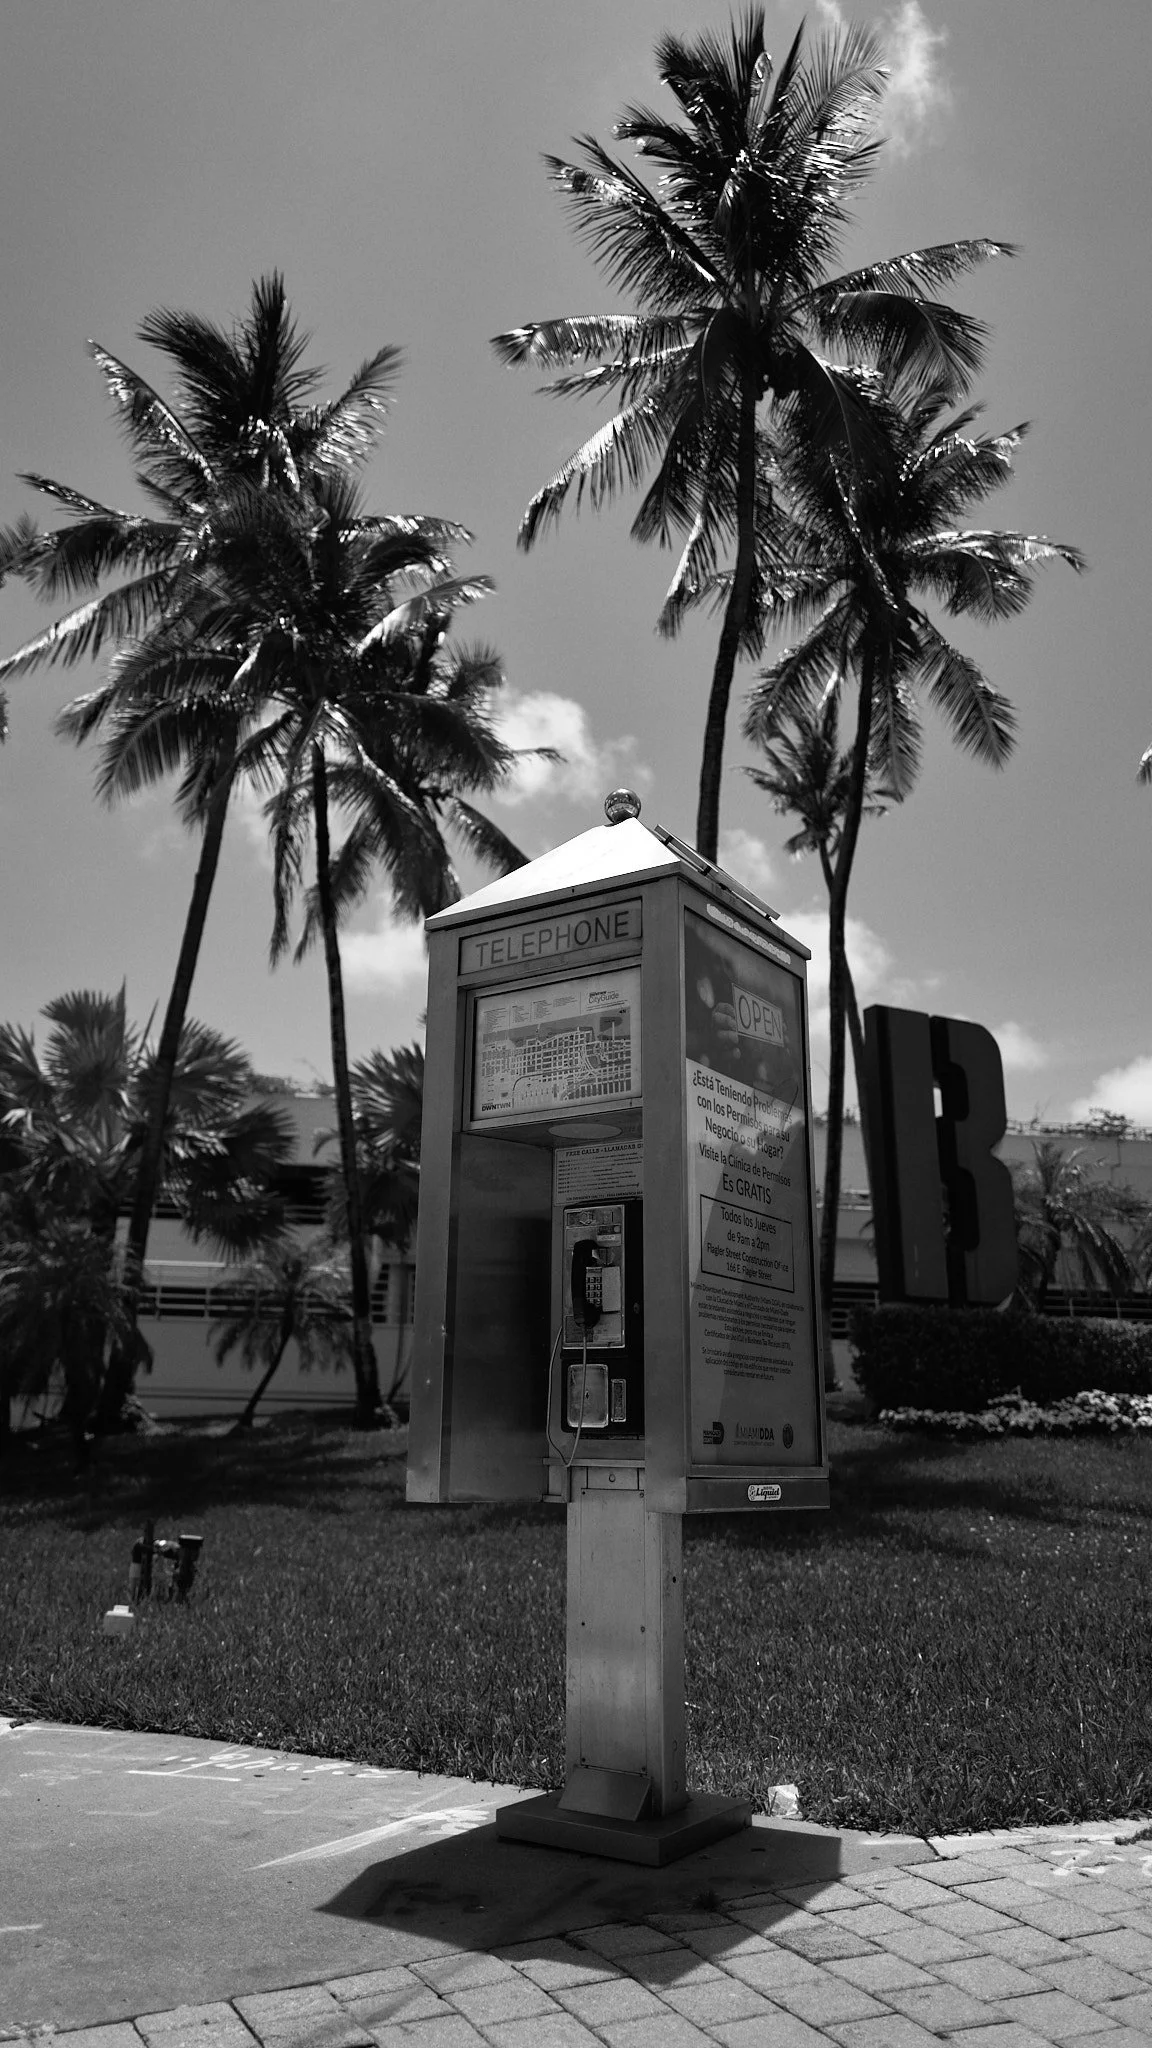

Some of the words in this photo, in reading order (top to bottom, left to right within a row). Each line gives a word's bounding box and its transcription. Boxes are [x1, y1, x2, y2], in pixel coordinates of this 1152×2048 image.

[475, 910, 630, 968] TELEPHONE
[588, 992, 619, 1004] CityGuide
[738, 994, 782, 1040] OPEN
[482, 1102, 511, 1112] DWNTWN
[692, 1069, 714, 1091] ¿Está
[715, 1078, 752, 1106] Teniendo
[753, 1094, 793, 1125] Problemas
[697, 1094, 712, 1112] con
[713, 1097, 725, 1117] los
[726, 1104, 762, 1132] Permisos
[763, 1122, 780, 1139] para
[781, 1130, 790, 1143] su
[705, 1116, 739, 1142] Negocio
[740, 1133, 746, 1146] o
[747, 1136, 756, 1149] su
[757, 1136, 784, 1160] Hogar?
[699, 1142, 719, 1162] Visite
[720, 1150, 727, 1165] la
[728, 1154, 751, 1174] Clínica
[752, 1161, 761, 1176] de
[762, 1165, 791, 1188] Permisos
[722, 1173, 734, 1193] Es
[736, 1178, 772, 1205] GRATIS
[720, 1206, 742, 1225] Todos
[743, 1212, 753, 1229] los
[754, 1217, 776, 1235] Jueves
[707, 1242, 725, 1257] Flagler
[725, 1247, 742, 1261] Street
[742, 1252, 774, 1268] Construction
[727, 1229, 736, 1242] de
[736, 1232, 750, 1247] 9am
[751, 1238, 756, 1248] a
[756, 1237, 770, 1253] 2pm
[726, 1262, 736, 1274] 166
[758, 1270, 772, 1281] Street
[755, 1487, 780, 1500] Liquid
